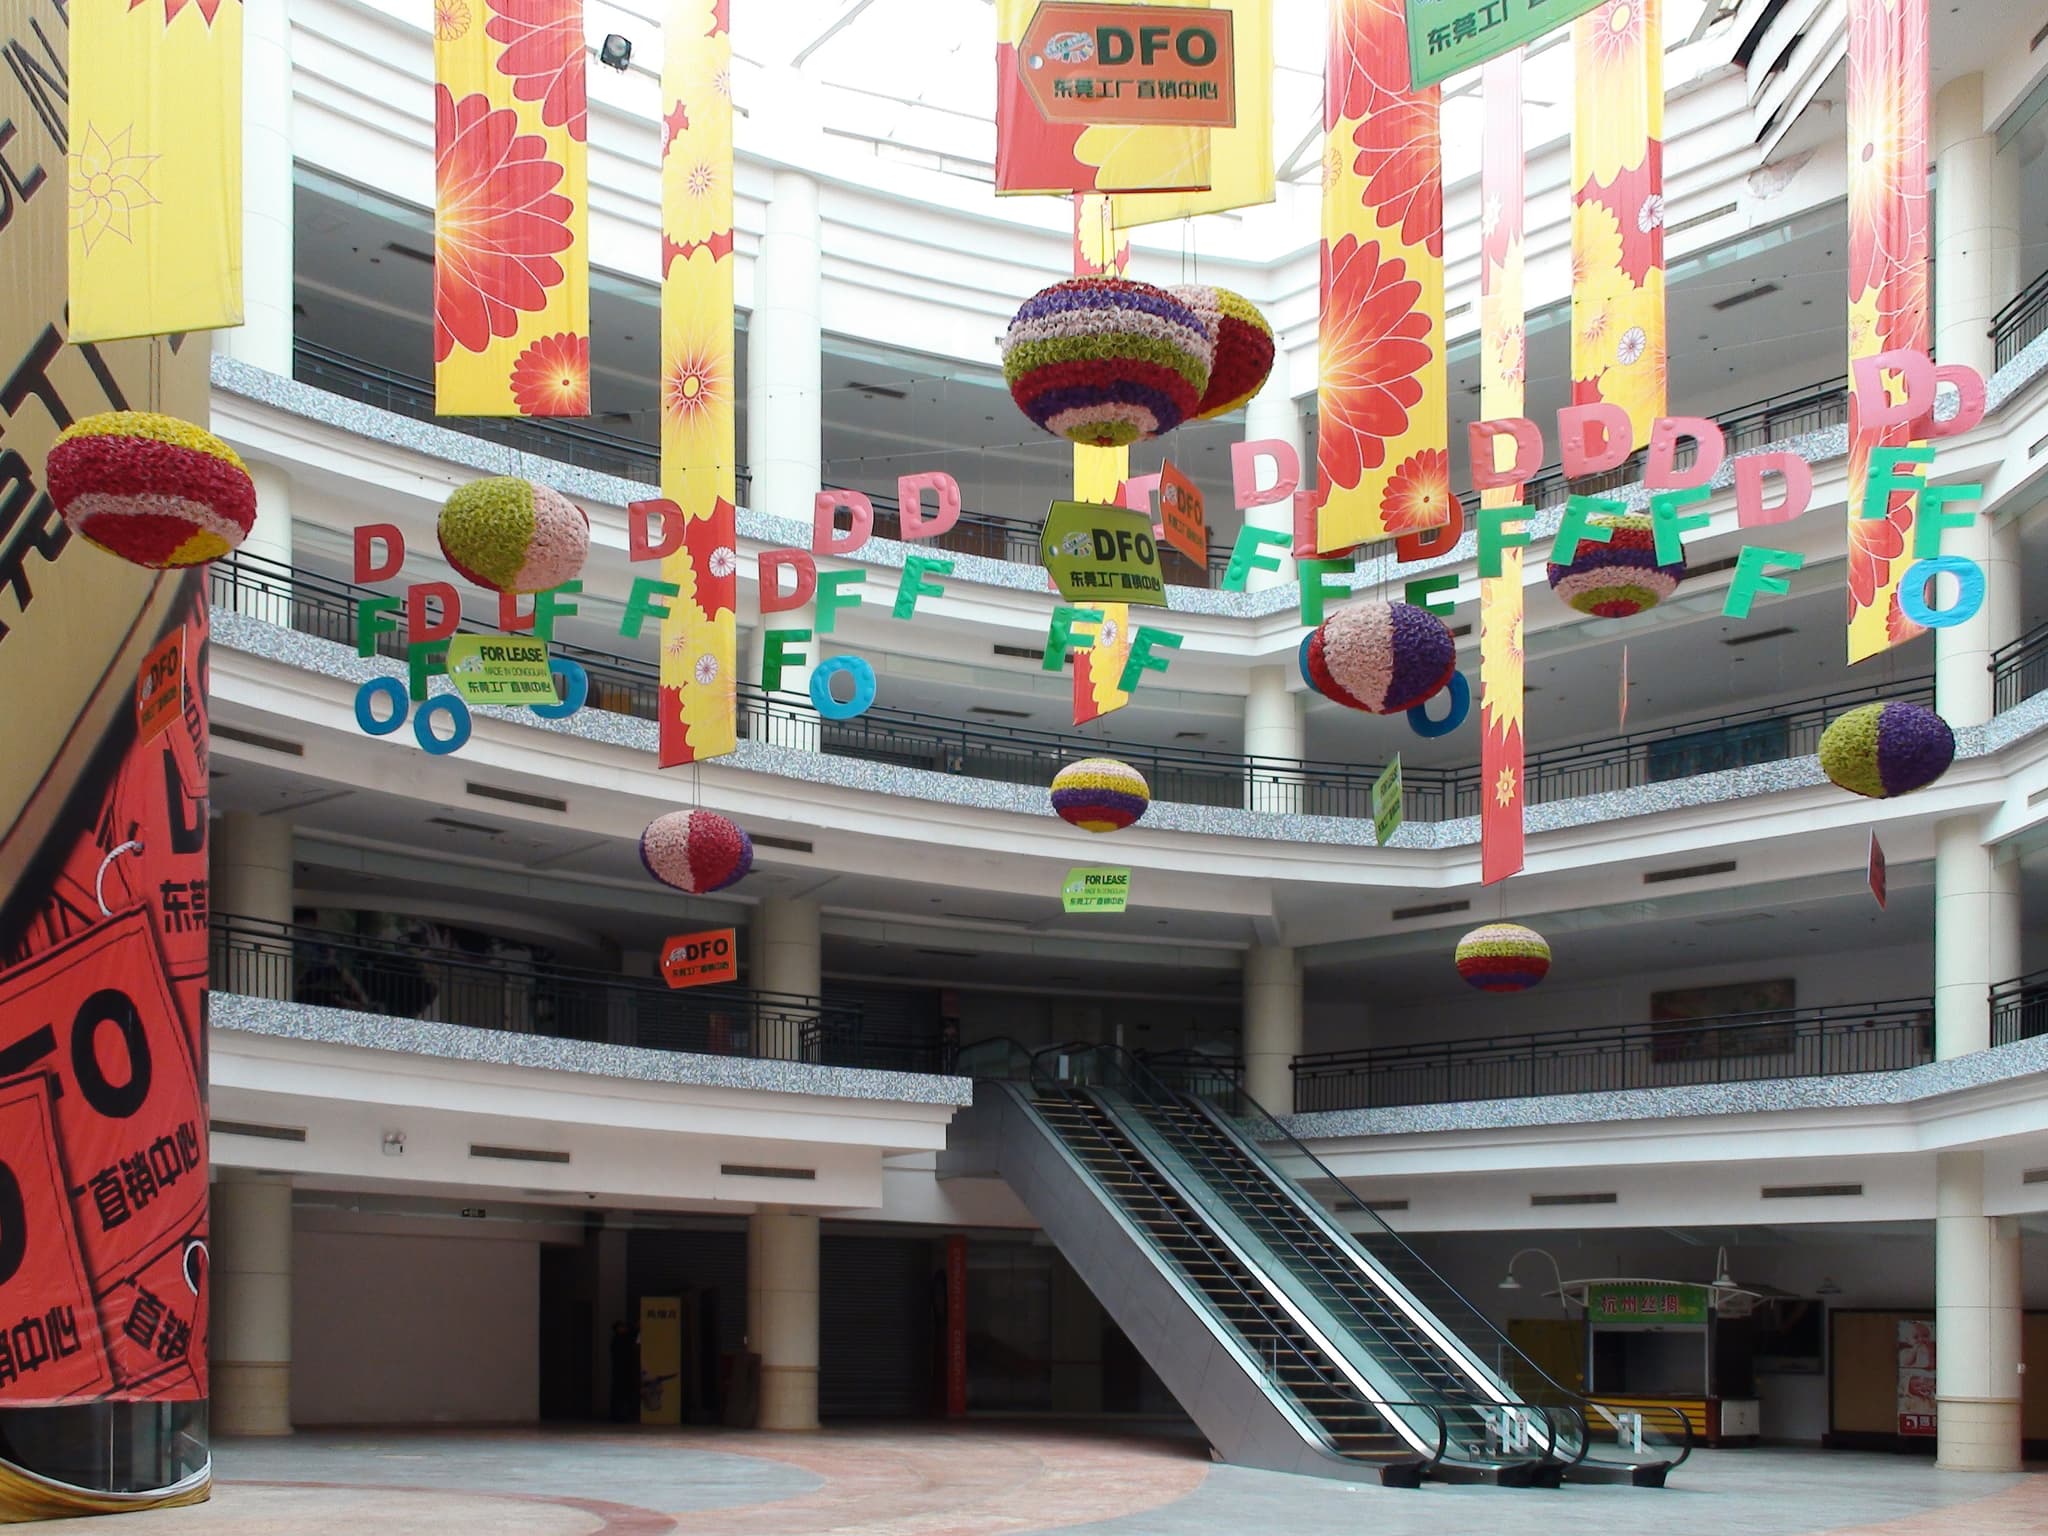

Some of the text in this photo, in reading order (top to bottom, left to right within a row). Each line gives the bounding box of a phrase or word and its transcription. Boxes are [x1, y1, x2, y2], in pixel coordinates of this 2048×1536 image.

[1096, 26, 1217, 66] DFO
[1053, 78, 1218, 99] 东莞工厂直销中心
[1853, 349, 1937, 521] D F
[1221, 439, 1300, 591] D F
[1468, 417, 1544, 579] D F
[1551, 403, 1632, 566] D F
[1643, 416, 1725, 567] D F
[354, 523, 405, 583] D
[892, 472, 961, 621] D F
[1092, 528, 1154, 565] DFO
[1721, 452, 1813, 619] D F
[1913, 484, 1983, 559] F
[619, 499, 686, 638] D F
[1897, 555, 1987, 628] O
[358, 597, 400, 658] F
[408, 582, 461, 643] D
[758, 548, 816, 691] D F
[810, 489, 876, 720] D F O
[151, 646, 177, 694] DFO
[480, 646, 544, 662] FOR LEASE
[1042, 607, 1104, 671] F
[1117, 626, 1184, 693] F
[1085, 875, 1127, 885] FOR LEASE
[686, 938, 729, 961] DFO
[1602, 1295, 1680, 1315] 杭州丝绸
